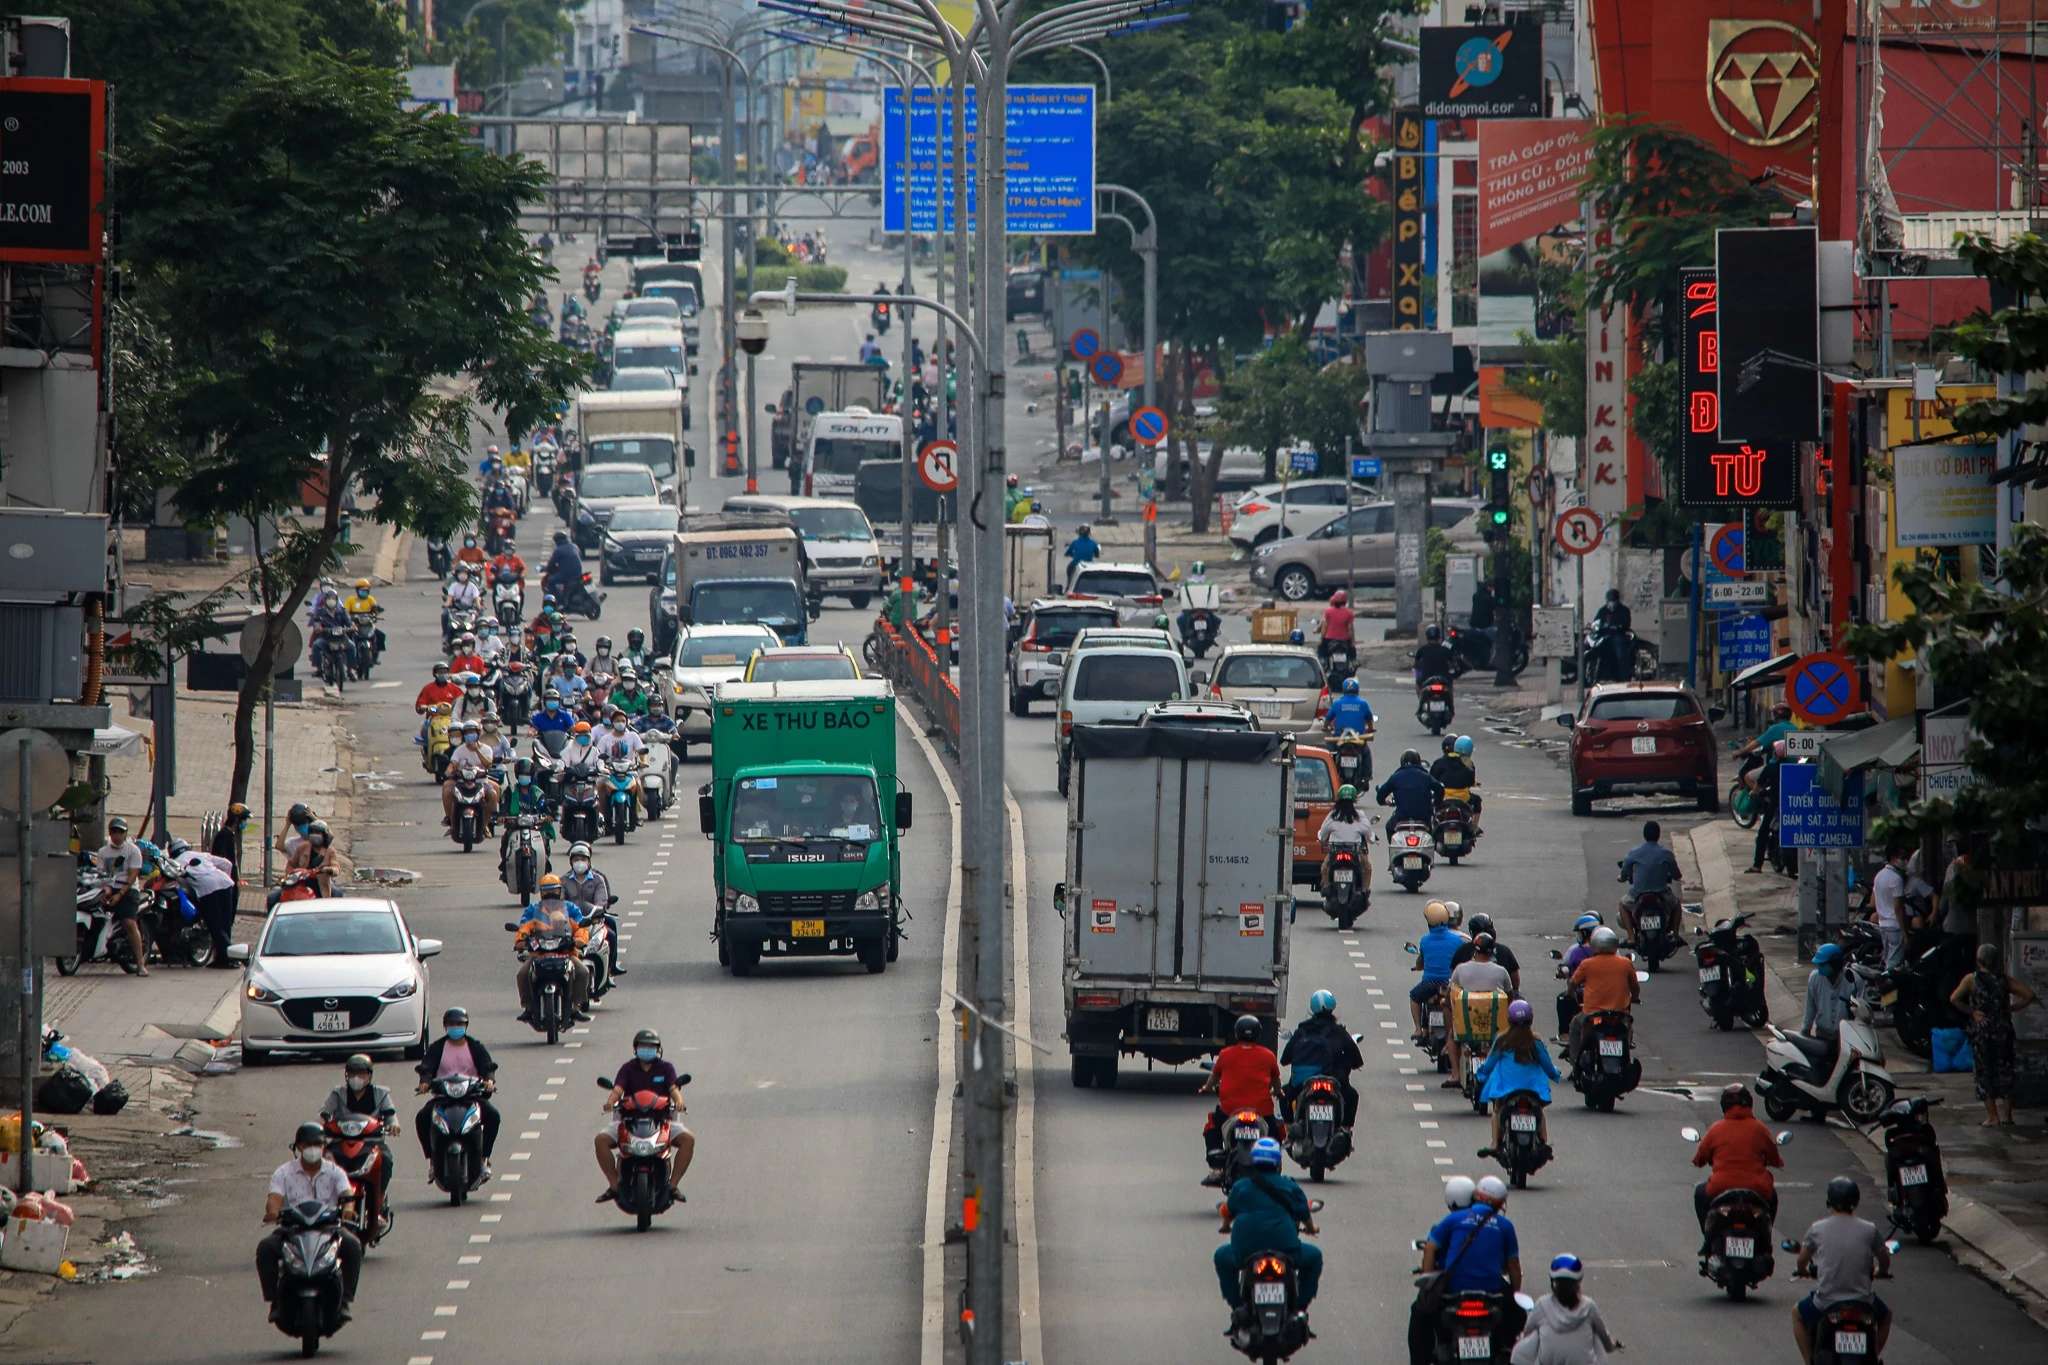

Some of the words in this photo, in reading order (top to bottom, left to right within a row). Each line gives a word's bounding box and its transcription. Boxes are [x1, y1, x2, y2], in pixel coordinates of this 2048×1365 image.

[3, 161, 29, 174] 2003
[830, 424, 890, 435] SOLATI
[1711, 446, 1766, 496] TỪ
[720, 545, 738, 559] 0962
[740, 545, 753, 558] 482
[755, 544, 768, 557] 357
[743, 713, 768, 731] XE
[775, 709, 818, 730] THƯ
[824, 707, 870, 729] BÁO
[1789, 738, 1814, 750] 6:00
[1928, 735, 1957, 761] INOX
[1788, 791, 1813, 807] TUYẾN
[1783, 811, 1802, 826] GIÁM
[1820, 833, 1853, 845] CAMERA
[788, 854, 826, 863] ISUZU
[801, 921, 816, 929] 29H
[796, 928, 821, 937] 334.69
[323, 1014, 339, 1022] 72A
[1155, 1009, 1172, 1020] 51C
[1149, 1018, 1178, 1031] 145.12
